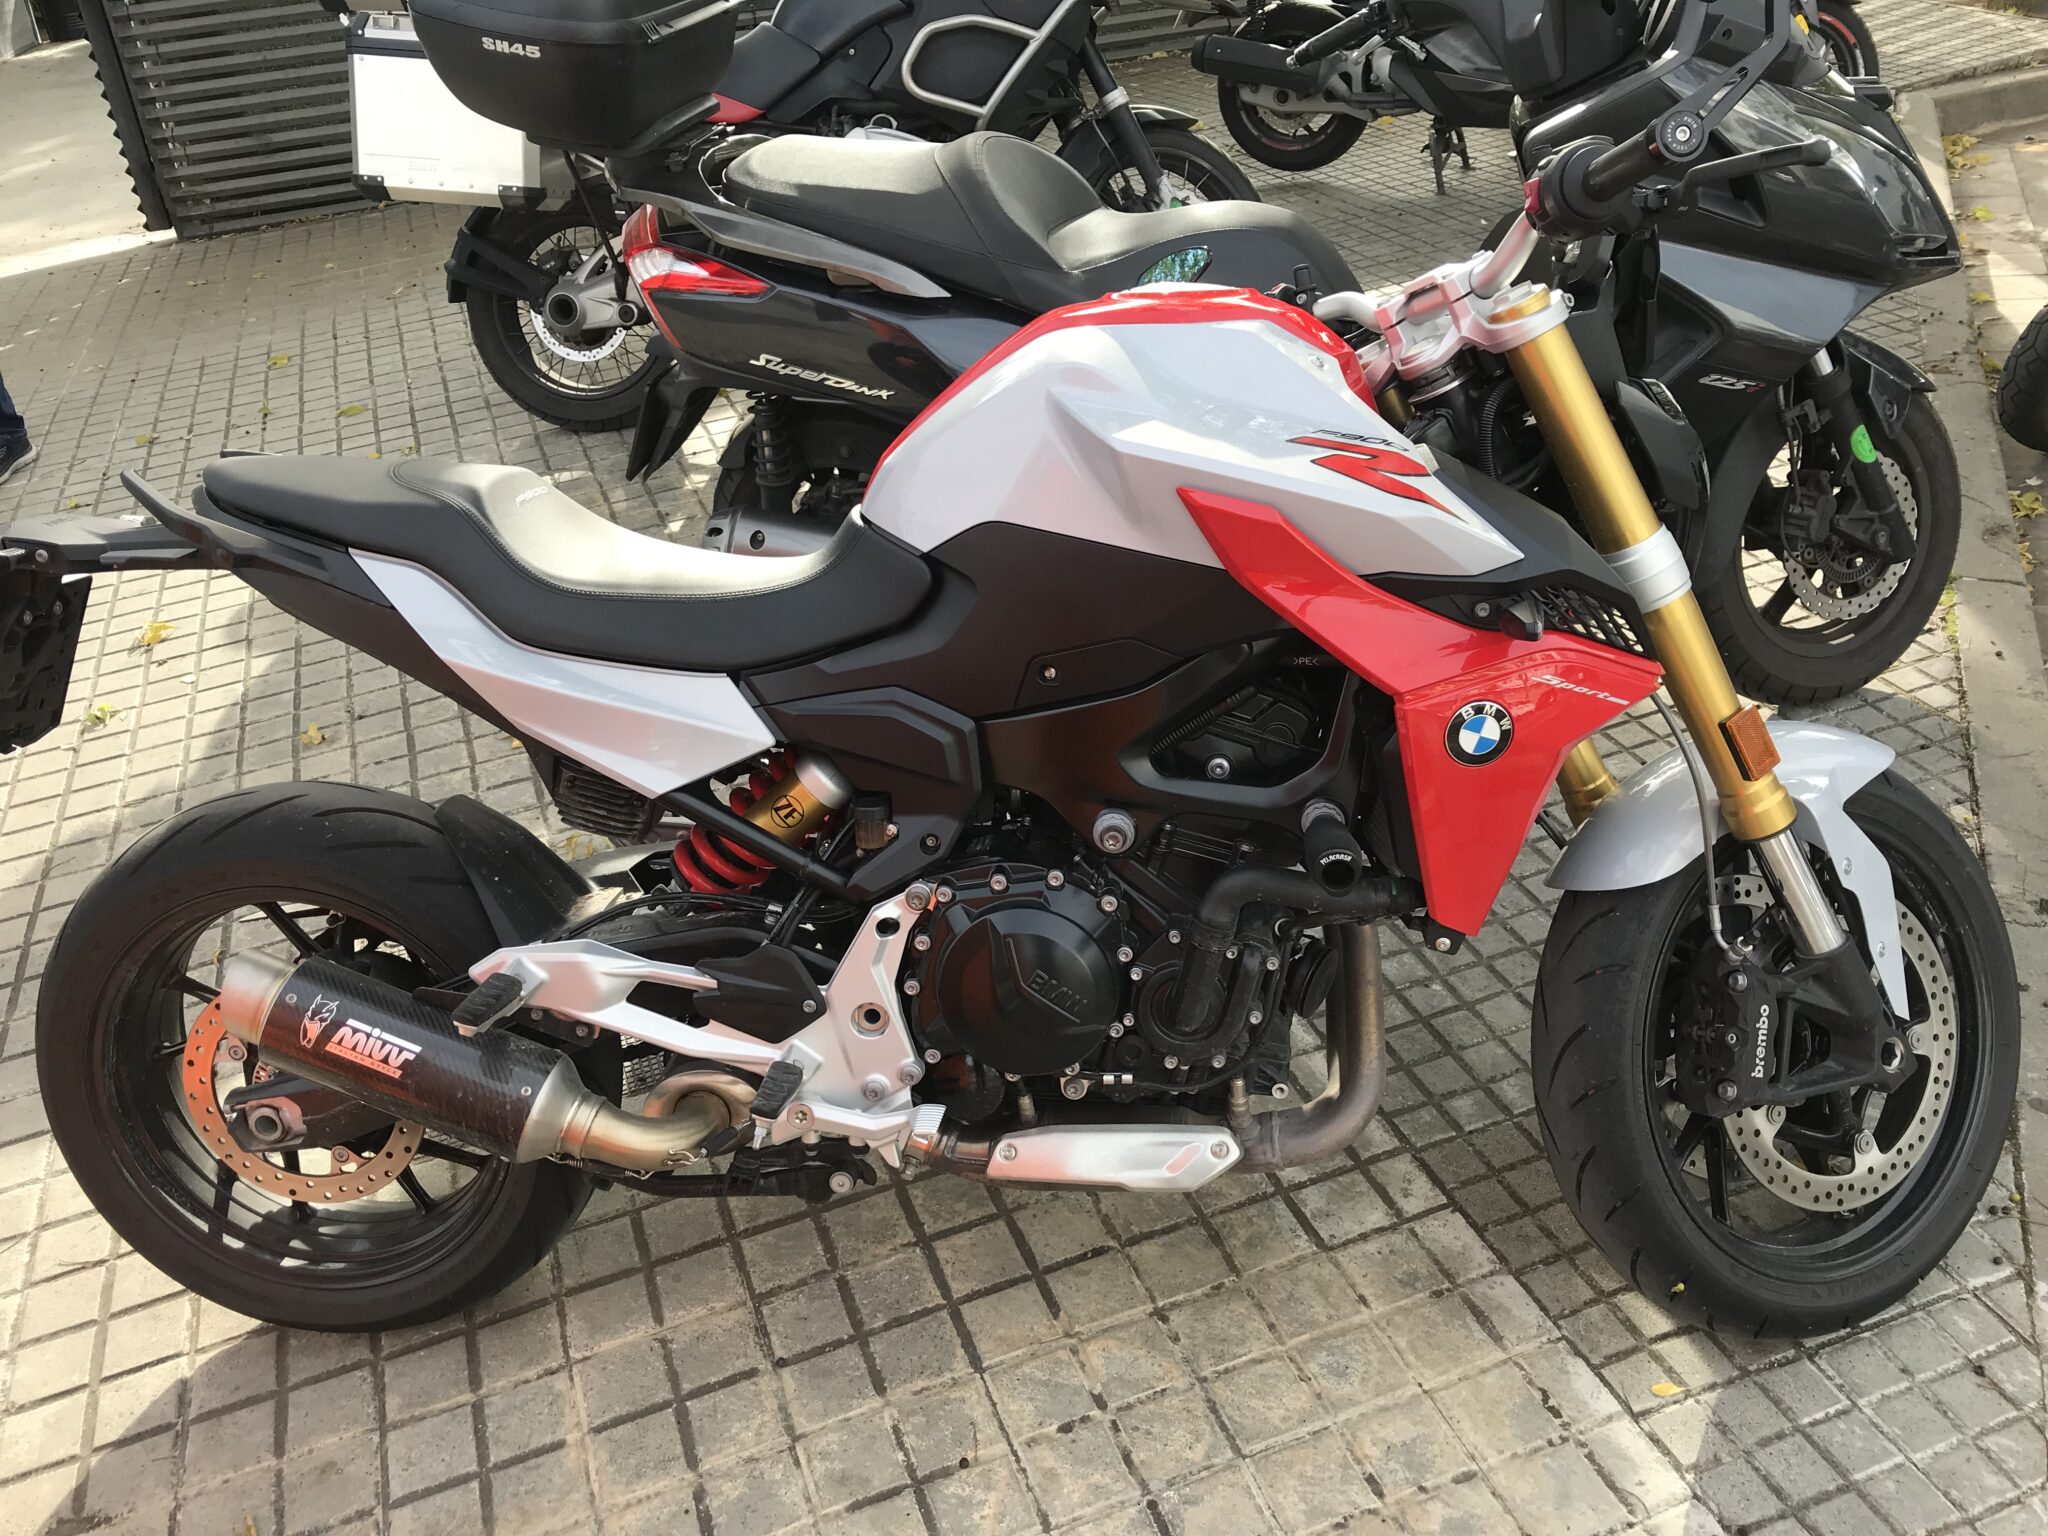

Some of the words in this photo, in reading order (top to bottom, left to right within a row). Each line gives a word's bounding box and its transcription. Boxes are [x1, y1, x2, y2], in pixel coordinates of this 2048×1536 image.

[481, 36, 541, 58] SH45
[1462, 704, 1512, 730] BMW
[1028, 969, 1088, 1014] BMW
[1751, 1004, 1770, 1078] brembo
